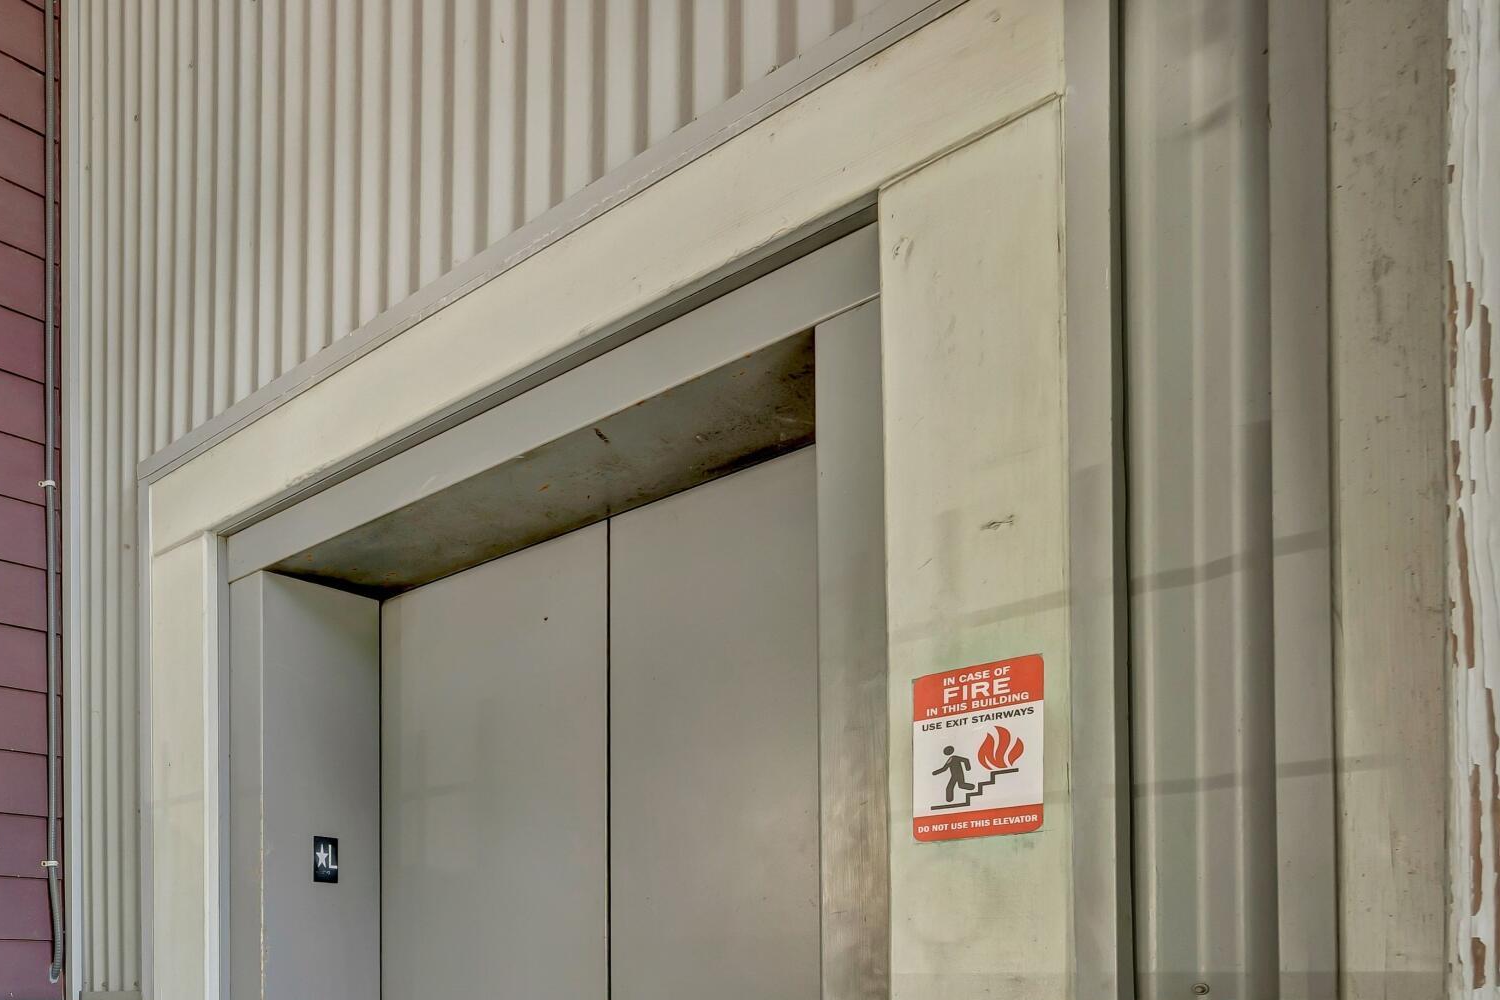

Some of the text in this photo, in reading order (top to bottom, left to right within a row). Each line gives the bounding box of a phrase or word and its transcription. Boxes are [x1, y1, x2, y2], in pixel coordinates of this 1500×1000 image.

[943, 666, 1010, 686] IN CASE OF
[943, 677, 1010, 704] FIRE
[927, 692, 1029, 716] IN THIS BUILDING
[922, 707, 1034, 731] USE EXIT STAIRWAYS
[918, 825, 930, 833] DO
[951, 822, 968, 830] USE
[970, 819, 990, 827] THIS
[993, 815, 1037, 825] ELEVATOR
